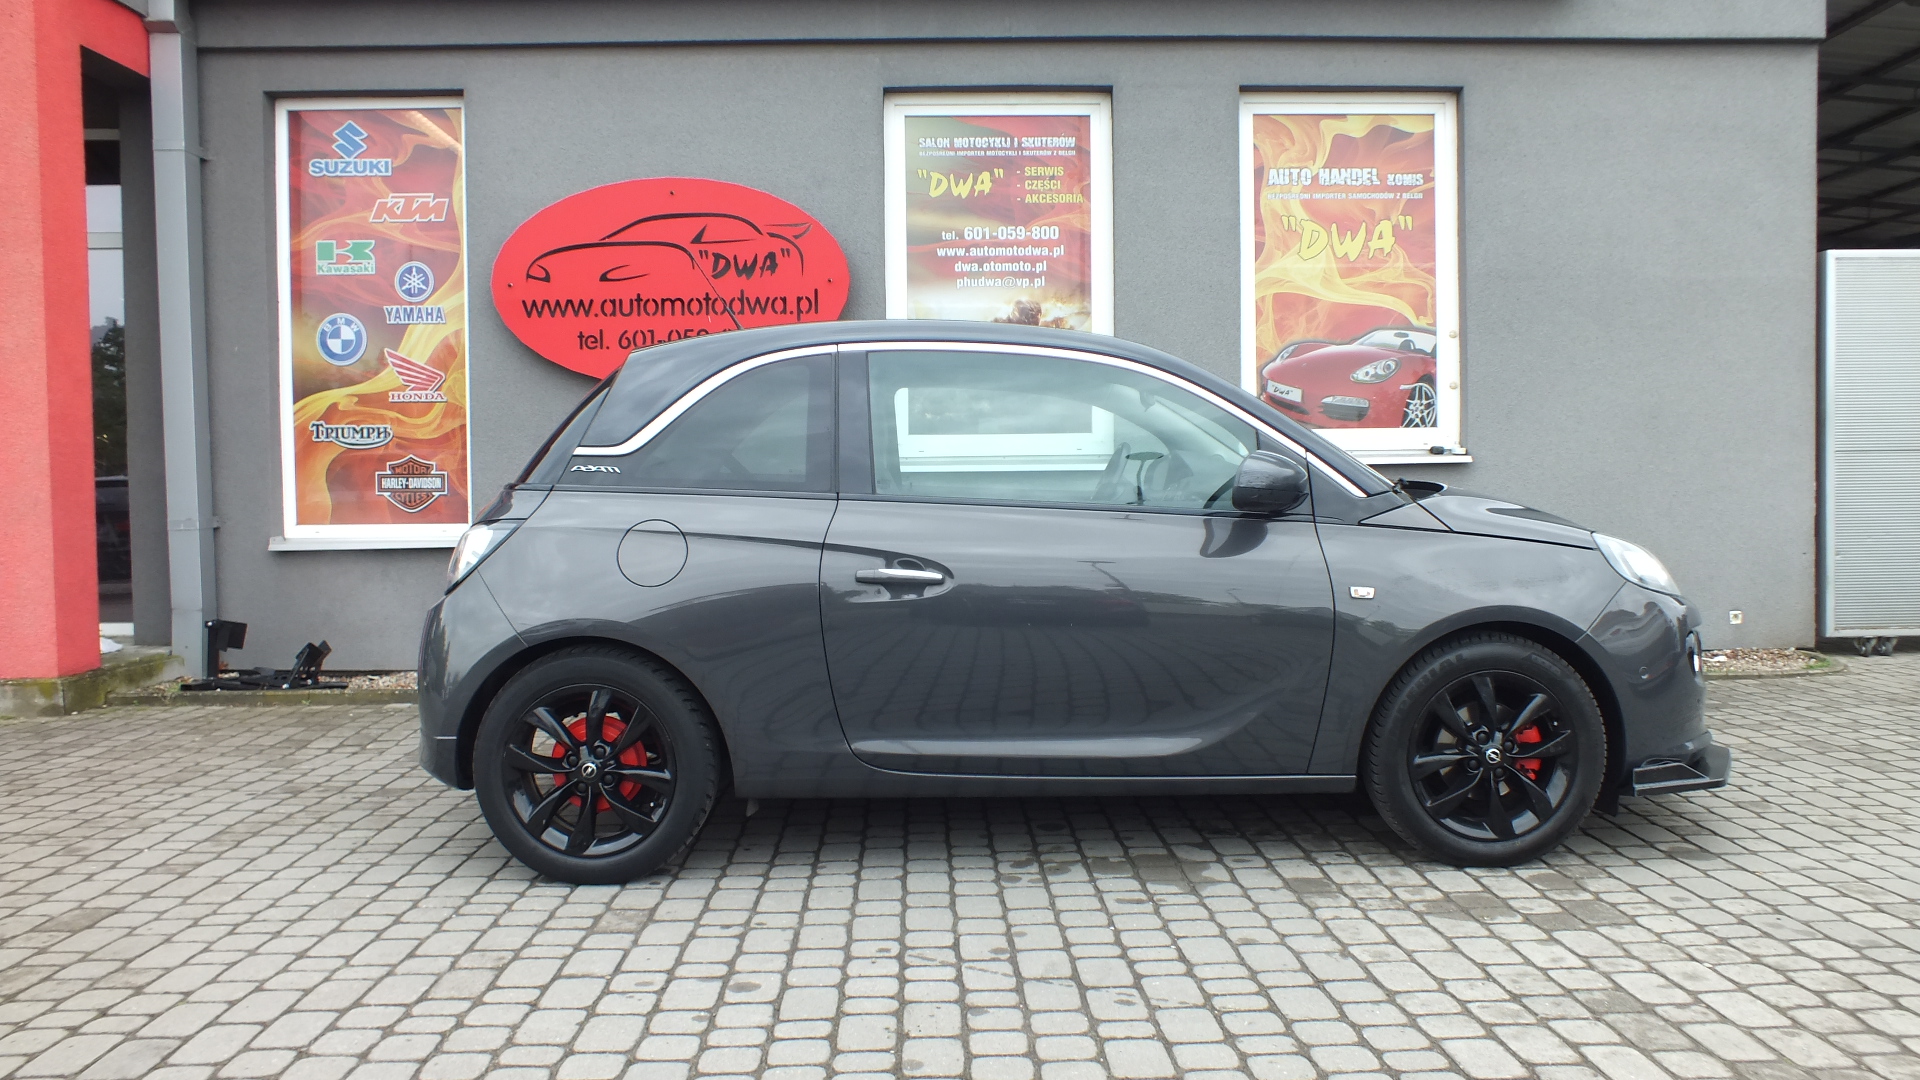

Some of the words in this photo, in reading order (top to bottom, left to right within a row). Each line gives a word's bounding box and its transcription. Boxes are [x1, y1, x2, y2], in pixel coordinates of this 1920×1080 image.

[919, 137, 950, 148] SALON
[953, 137, 1011, 148] MOTOCYKLI
[1021, 133, 1076, 148] SKUTERÓW
[310, 159, 391, 175] SUZUKI
[1024, 166, 1064, 177] SERWIS
[917, 168, 1004, 198] "DWA"
[1267, 168, 1312, 186] AUTO
[1318, 168, 1381, 186] HANDEL
[1387, 173, 1424, 186] KOMIS
[1024, 178, 1061, 192] CZĘŚCI
[1024, 193, 1084, 204] AKCESORIA
[370, 193, 448, 222] KTM
[941, 230, 960, 241] tel.
[964, 225, 1060, 241] 601-059-800
[1281, 215, 1413, 262] "DWA"
[936, 245, 1065, 258] www.automotodwa.pl
[317, 263, 375, 274] Kawasaki
[698, 247, 791, 280] "DWA"
[954, 260, 1047, 273] dwa.otomoto.pl
[956, 276, 1046, 289] phudwa@vp.pl
[522, 288, 819, 321] www.automotodwa.pl
[385, 306, 446, 324] YAMAHA
[323, 317, 360, 332] BMW
[577, 329, 610, 350] tel.
[390, 392, 446, 401] HONDA
[311, 422, 391, 440] TRIUMPH
[395, 462, 428, 474] MOTOR
[381, 477, 442, 489] HARLEY-DAVIDSON
